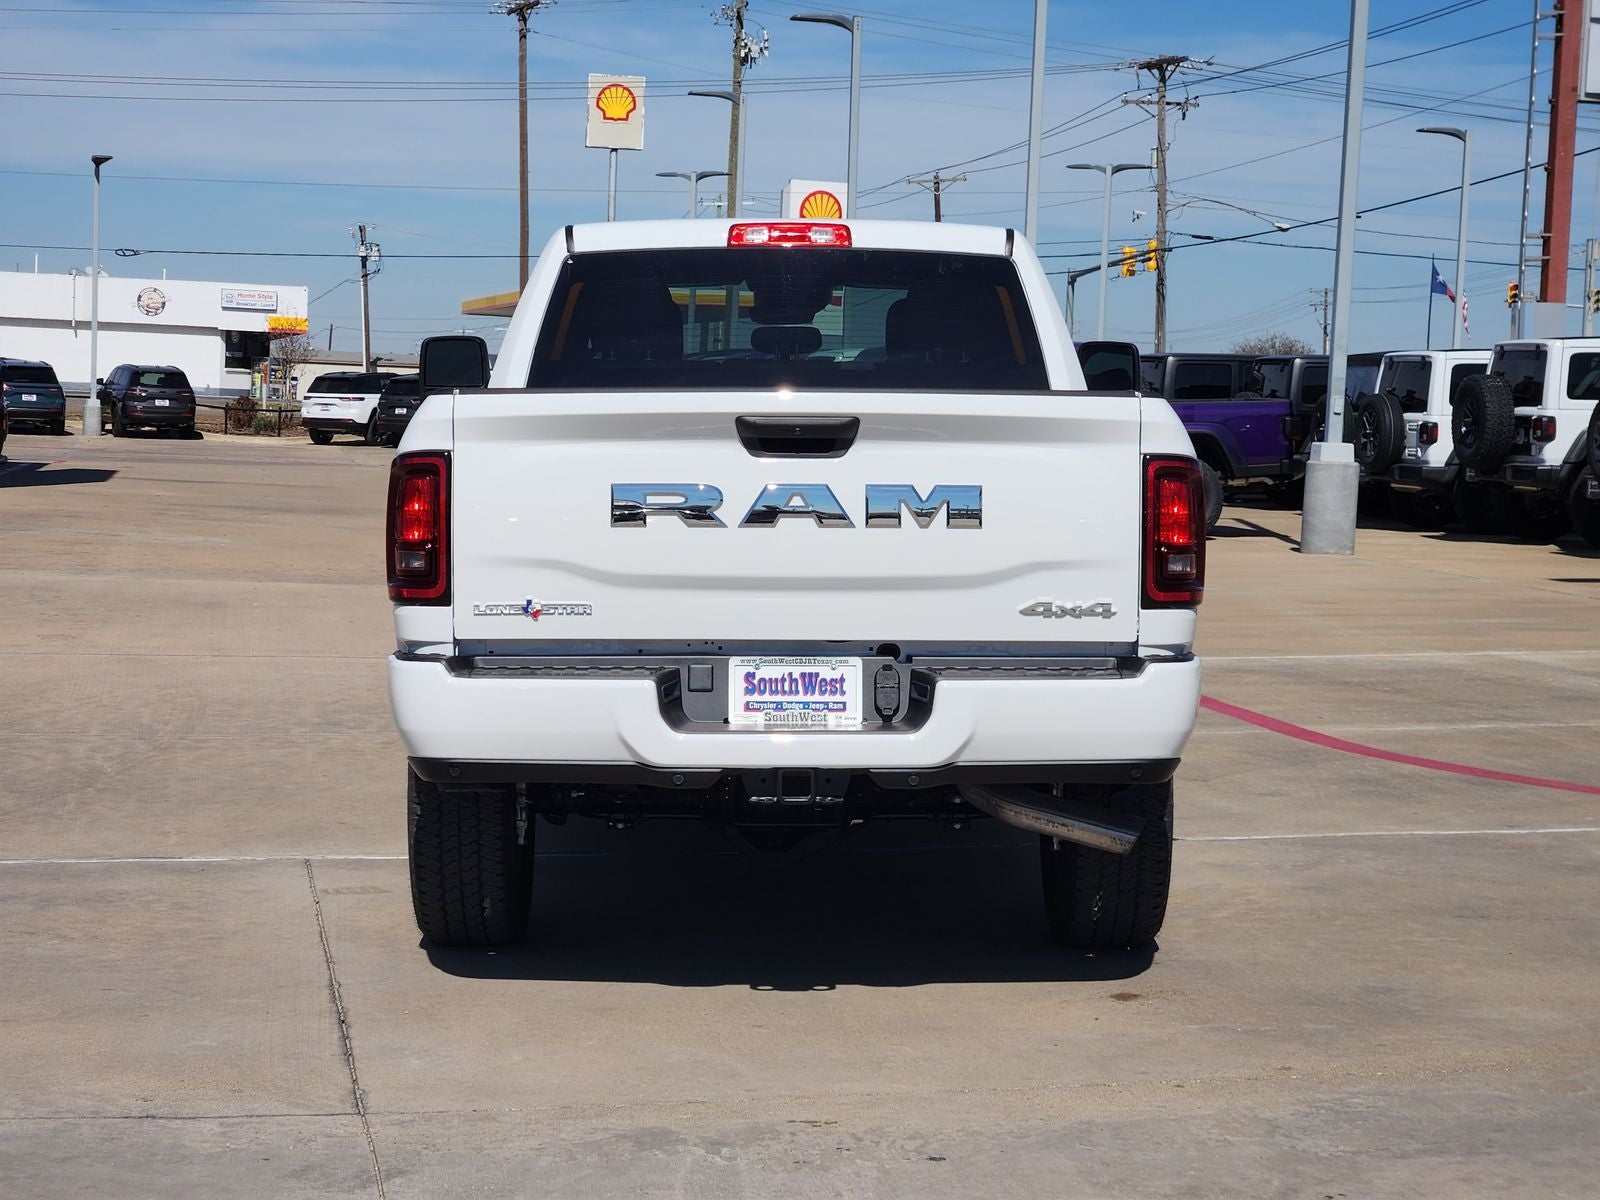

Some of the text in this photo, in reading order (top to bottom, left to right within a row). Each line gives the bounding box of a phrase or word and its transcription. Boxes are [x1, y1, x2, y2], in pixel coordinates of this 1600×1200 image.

[610, 483, 983, 529] RAM
[473, 604, 592, 616] LONE STAR
[1018, 602, 1118, 619] 4x4
[744, 671, 846, 697] SouthWest
[749, 702, 776, 710] Chrysler
[783, 702, 803, 710] Dodge
[809, 702, 824, 710] Jeep
[764, 712, 828, 722] SouthWest
